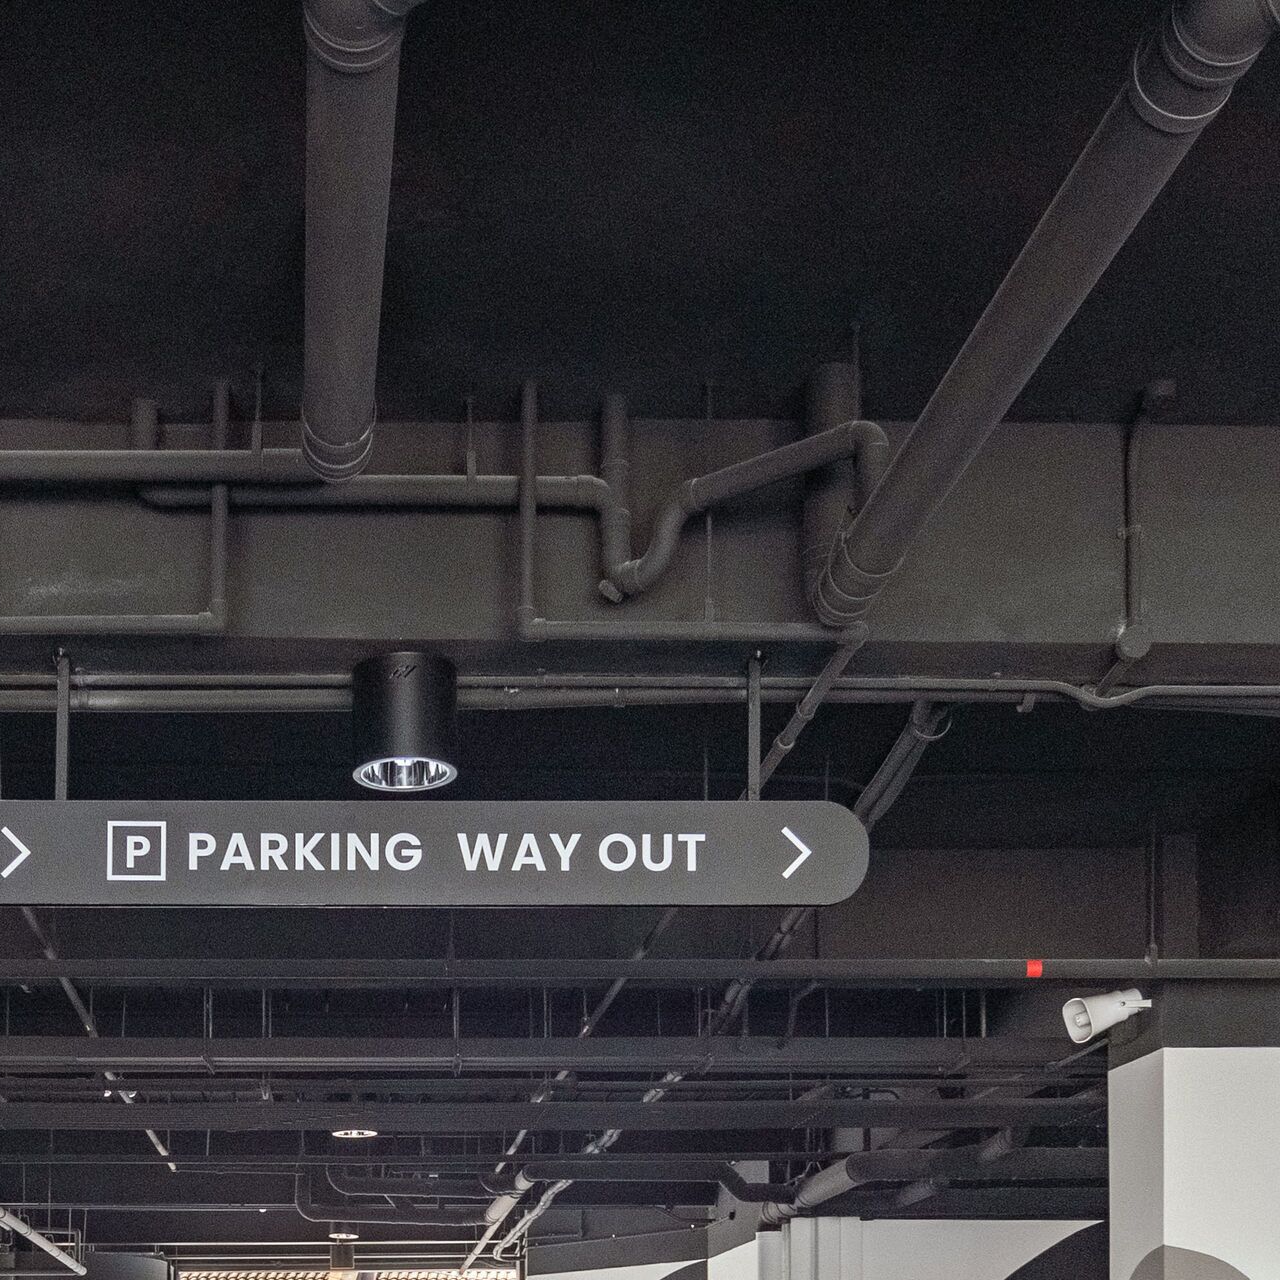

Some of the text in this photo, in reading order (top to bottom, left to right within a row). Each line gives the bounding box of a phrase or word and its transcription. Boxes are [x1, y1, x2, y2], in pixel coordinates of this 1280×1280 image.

[126, 832, 706, 872] P PARKING WAY OUT
